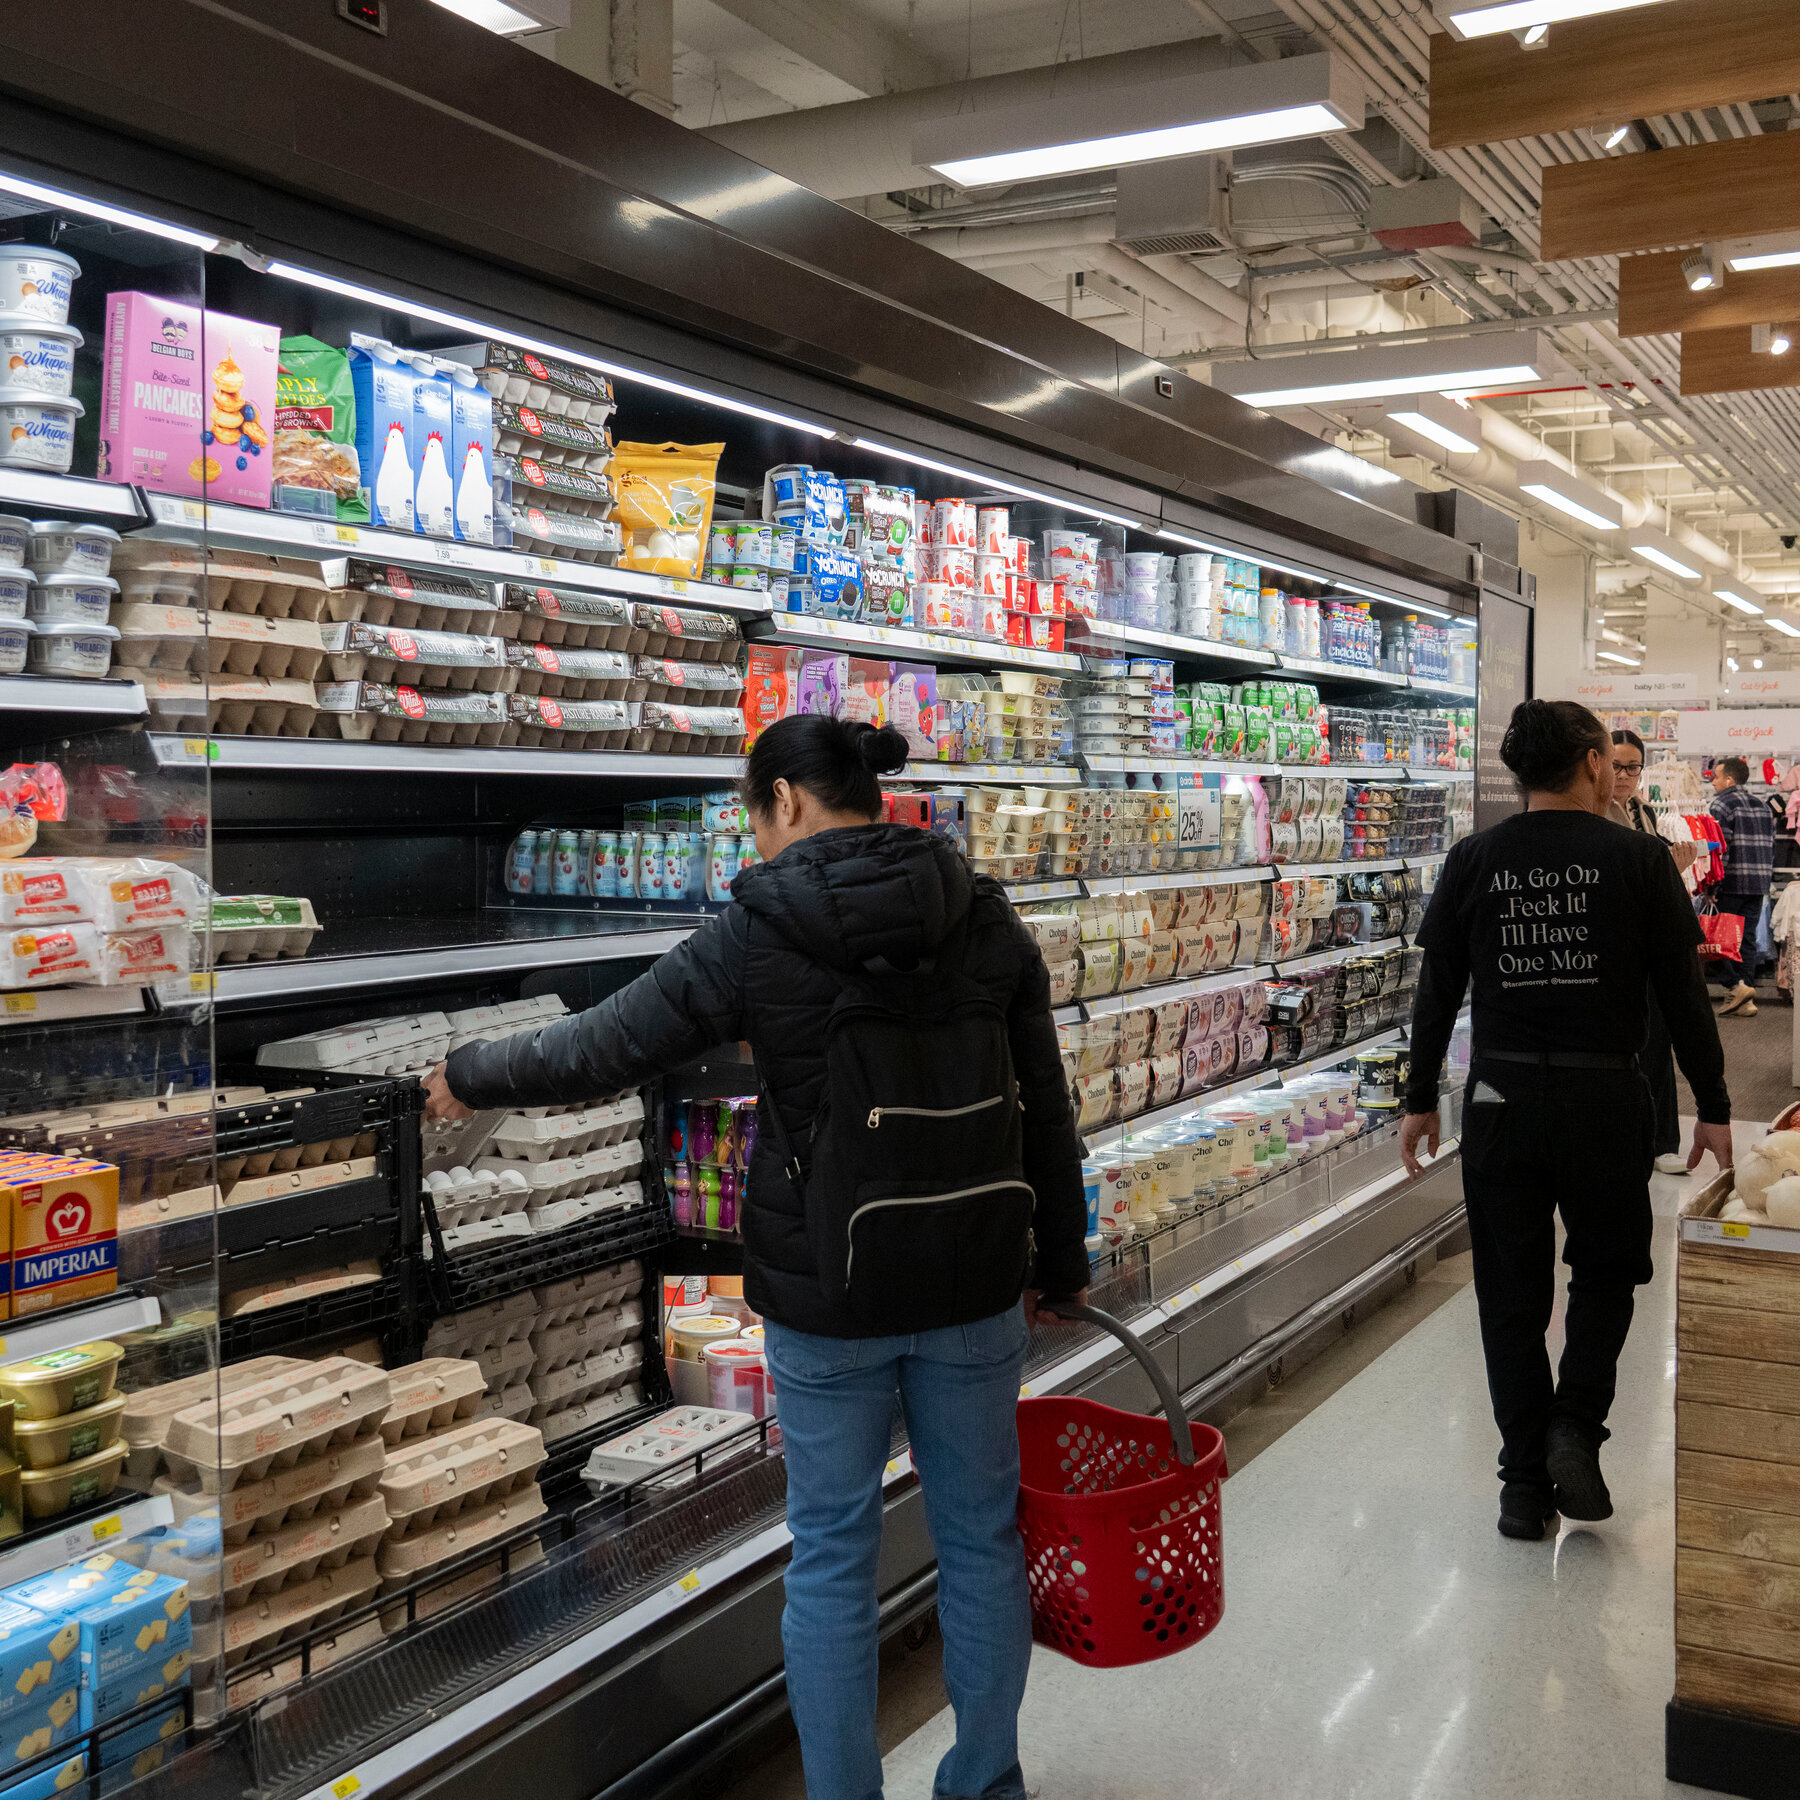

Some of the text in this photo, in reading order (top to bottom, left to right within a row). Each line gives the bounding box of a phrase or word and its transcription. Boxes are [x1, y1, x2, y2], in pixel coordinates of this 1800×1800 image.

[116, 302, 126, 343] ANYTIME
[152, 342, 193, 360] BELGIAN BOYS
[526, 359, 543, 373] Vital
[546, 367, 596, 393] PASTURE-RAISED
[134, 381, 204, 420] PANCAKES
[521, 414, 537, 428] Vital
[540, 419, 594, 444] PASTURE-RAISED
[524, 464, 540, 478] Vital
[544, 469, 597, 493] PASTURE-RAISED
[540, 595, 558, 610] Vital
[560, 600, 613, 616] PASTURE-RAISED
[664, 614, 680, 628] Vital
[682, 618, 726, 633] PASTURE-RAISED
[390, 632, 412, 651] Vital
[417, 640, 484, 657] PASTURE-RAISED
[537, 650, 556, 665] Vital
[558, 653, 612, 668] PASTURE-RAISED
[665, 664, 682, 678] Vital
[683, 668, 728, 681] PASTURE-RAISED
[1578, 685, 1590, 694] Cat
[1596, 684, 1613, 696] Jack
[1634, 683, 1652, 692] baby
[1740, 682, 1753, 690] Cat
[1760, 681, 1778, 693] Jack
[400, 692, 421, 708] Vital
[424, 696, 489, 714] PASTURE-RAISED
[542, 704, 558, 718] Vital
[562, 706, 616, 721] PASTURE-RAISED
[1728, 726, 1742, 737] Cat
[1752, 726, 1774, 741] Jack
[1181, 810, 1204, 842] 25 %
[1194, 827, 1203, 841] off
[1488, 864, 1600, 893] Ah, Go On
[1566, 892, 1588, 914] It!
[1500, 922, 1588, 946] I'll Have
[1092, 952, 1112, 964] Chobani
[1498, 949, 1598, 974] One Mór
[1087, 1086, 1106, 1100] Chobani
[24, 1247, 110, 1284] IMPERIAL
